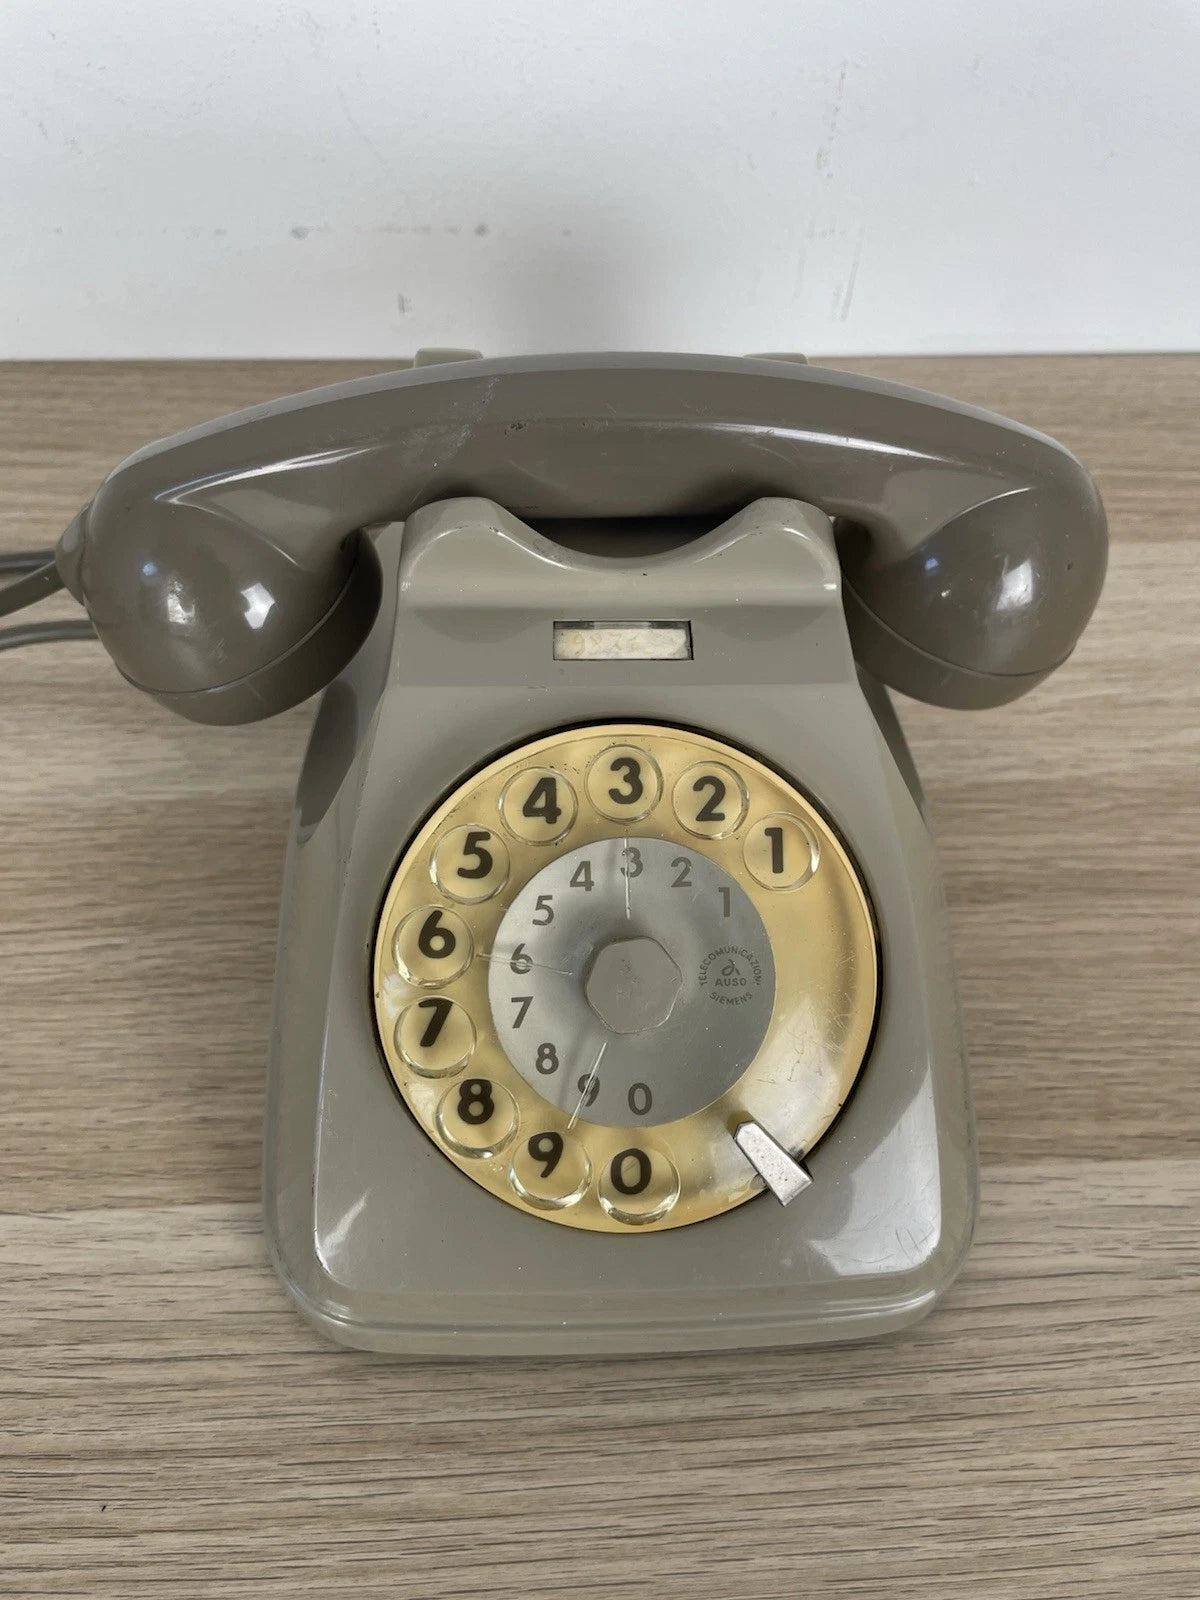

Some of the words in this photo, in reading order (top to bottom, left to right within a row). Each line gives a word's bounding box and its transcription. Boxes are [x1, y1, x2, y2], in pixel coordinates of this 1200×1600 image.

[608, 758, 642, 803] 3
[522, 777, 561, 824] 4
[693, 776, 726, 822] 2
[457, 831, 493, 879] 5
[620, 847, 643, 877] 3
[765, 827, 784, 874] 1
[570, 861, 594, 891] 4
[670, 856, 693, 887] 2
[532, 895, 554, 926] 5
[718, 887, 730, 917] 1
[418, 910, 455, 958] 6
[510, 943, 533, 975] 6
[715, 978, 746, 986] AUSO
[511, 996, 534, 1028] 7
[710, 992, 752, 1005] SIEMENS
[418, 999, 453, 1046] 7
[535, 1042, 558, 1074] 8
[457, 1079, 495, 1125] 8
[577, 1074, 600, 1106] 9
[627, 1083, 652, 1115] 0
[527, 1131, 564, 1178] 9
[610, 1148, 651, 1195] 0
